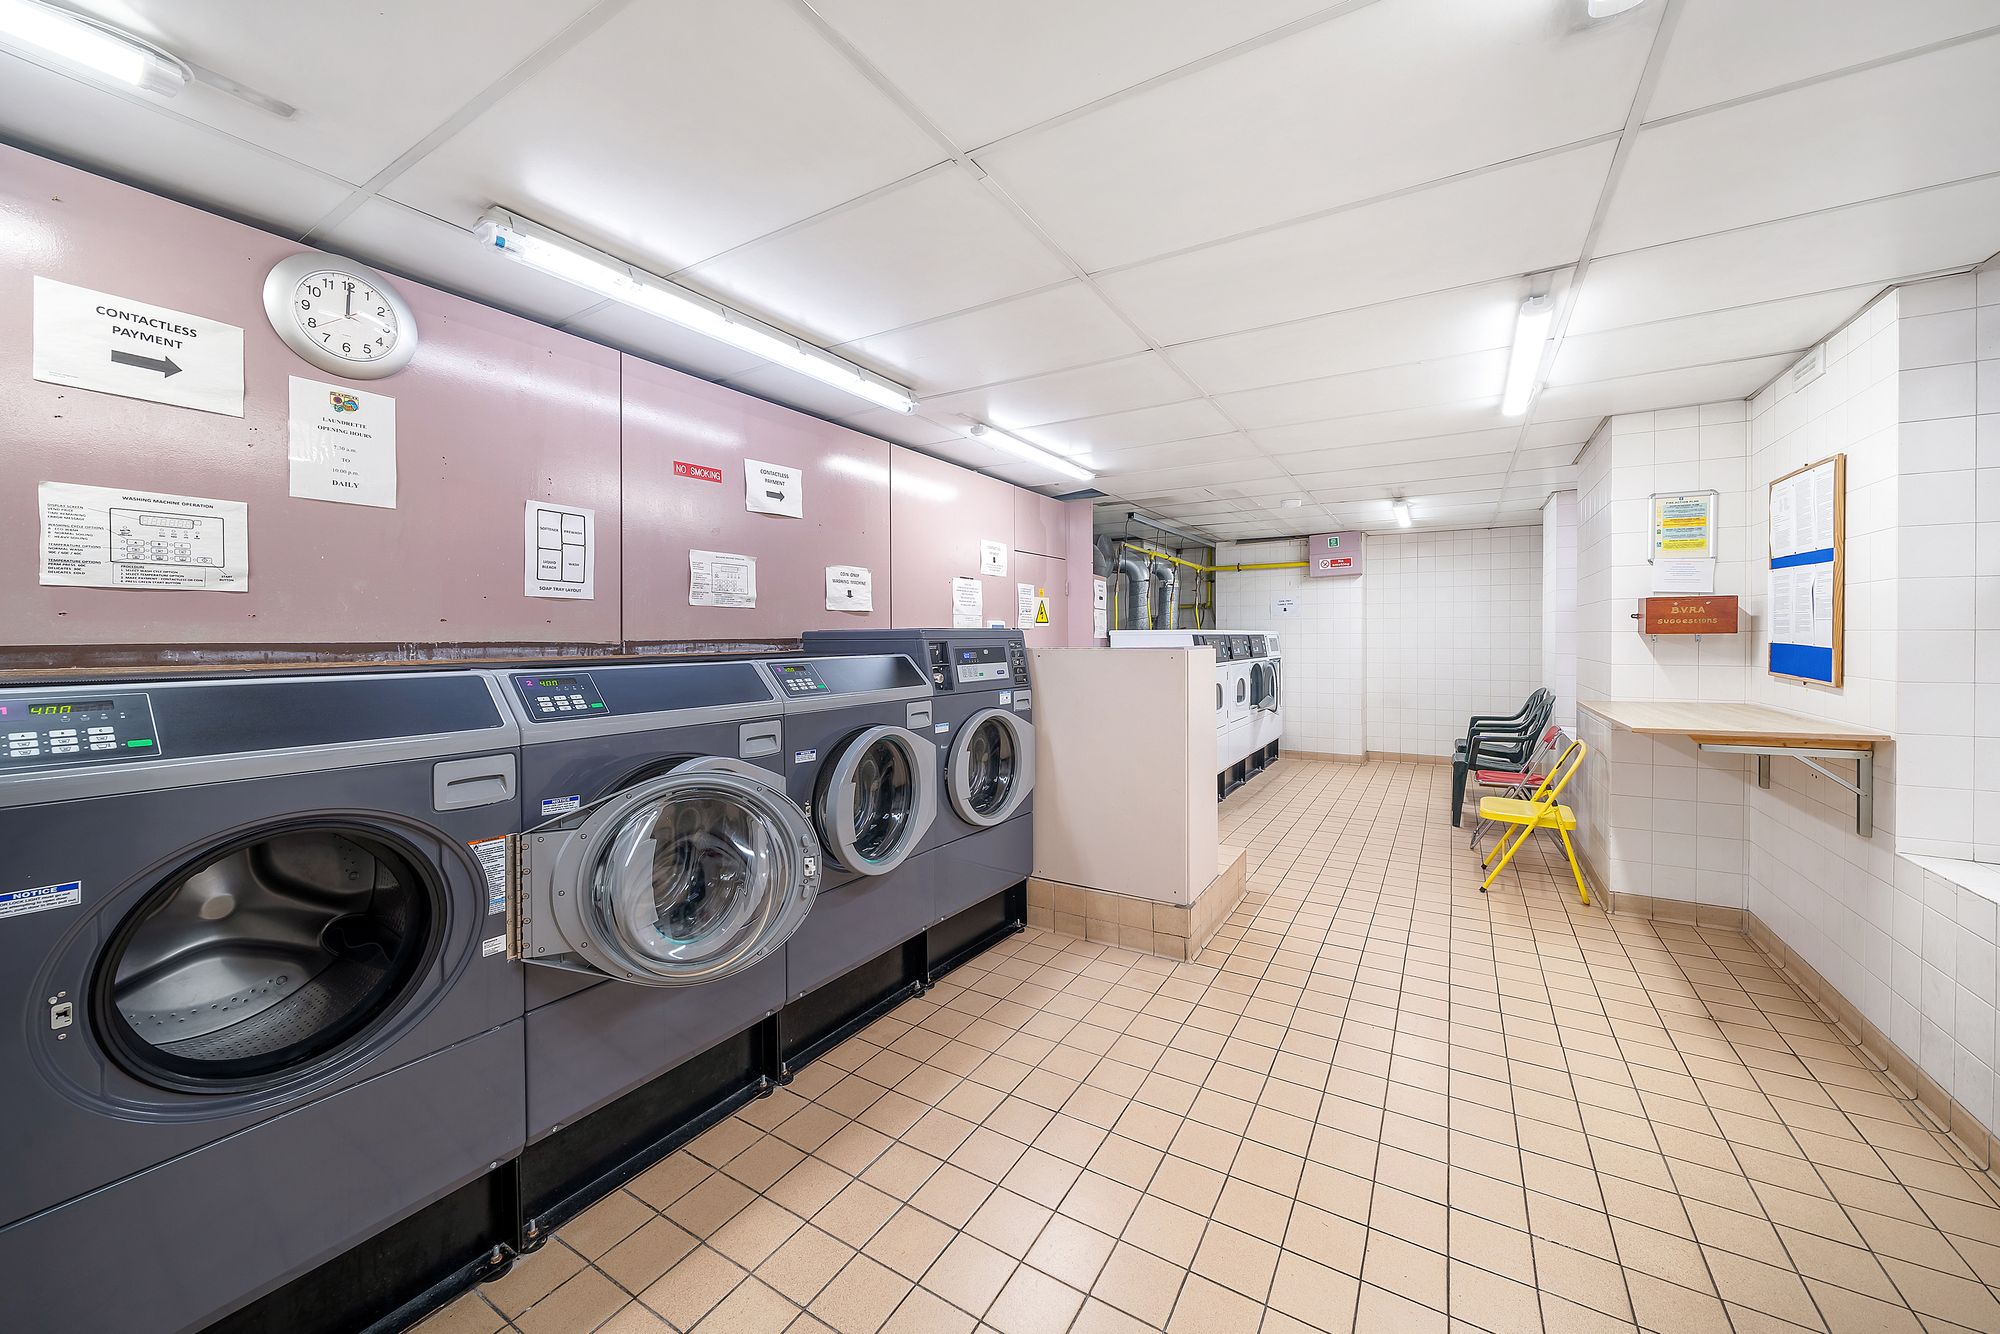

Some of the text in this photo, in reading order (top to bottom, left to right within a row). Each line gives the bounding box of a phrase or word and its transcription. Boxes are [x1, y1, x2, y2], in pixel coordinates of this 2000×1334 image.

[322, 278, 334, 290] 11
[306, 285, 321, 298] 10
[365, 292, 370, 301] 1
[301, 300, 310, 310] 9
[377, 307, 385, 317] 2
[96, 306, 198, 338] CONTACTLESS
[308, 318, 316, 328] 8
[112, 326, 183, 349] PAYMENT
[322, 332, 331, 342] 7
[376, 337, 383, 346] 4
[342, 343, 351, 353] 6
[363, 344, 371, 354] 5
[322, 417, 367, 430] LAUNDRETTE
[317, 425, 348, 435] OPENING
[676, 464, 720, 480] NO SMOKING
[760, 469, 789, 479] CONTACTLESS
[332, 480, 360, 488] DAILY
[764, 478, 785, 486] PAYMENT
[12, 886, 58, 900] NOTICE
